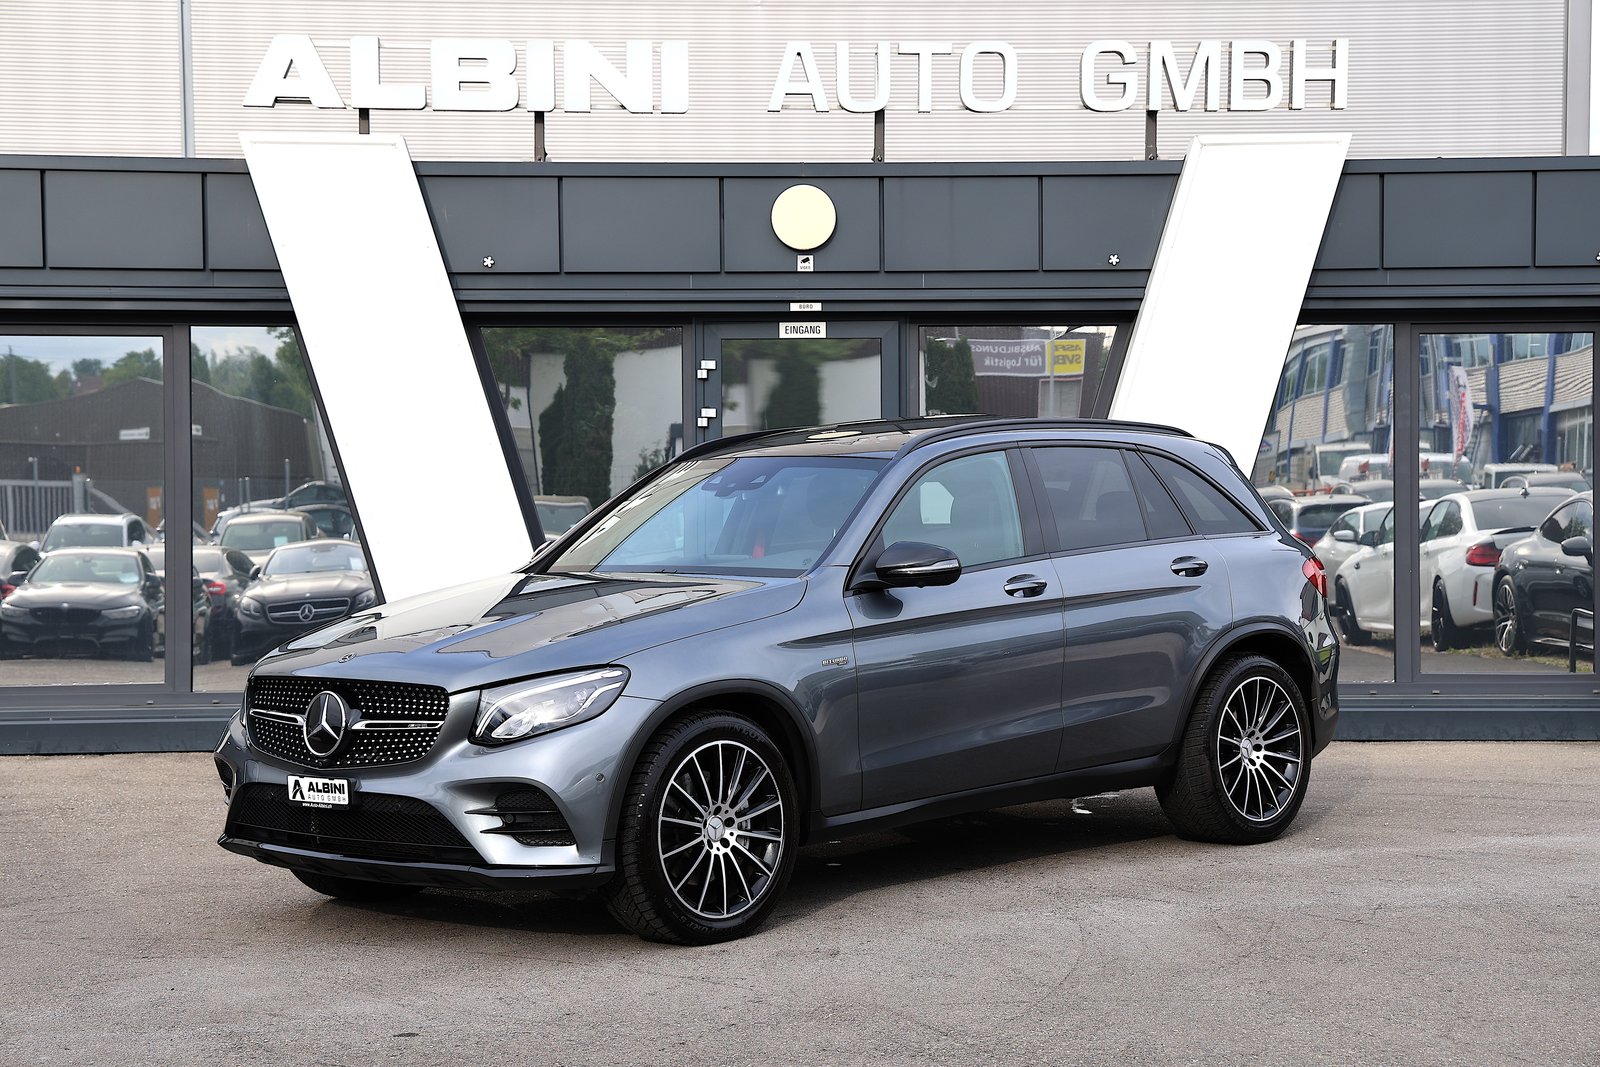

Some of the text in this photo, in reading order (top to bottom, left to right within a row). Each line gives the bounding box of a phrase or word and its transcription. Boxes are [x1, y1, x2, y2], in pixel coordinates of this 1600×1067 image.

[243, 34, 1349, 114] ALBINI AUTO GMBH
[785, 326, 820, 334] EINGANG
[307, 781, 345, 794] ALBINI
